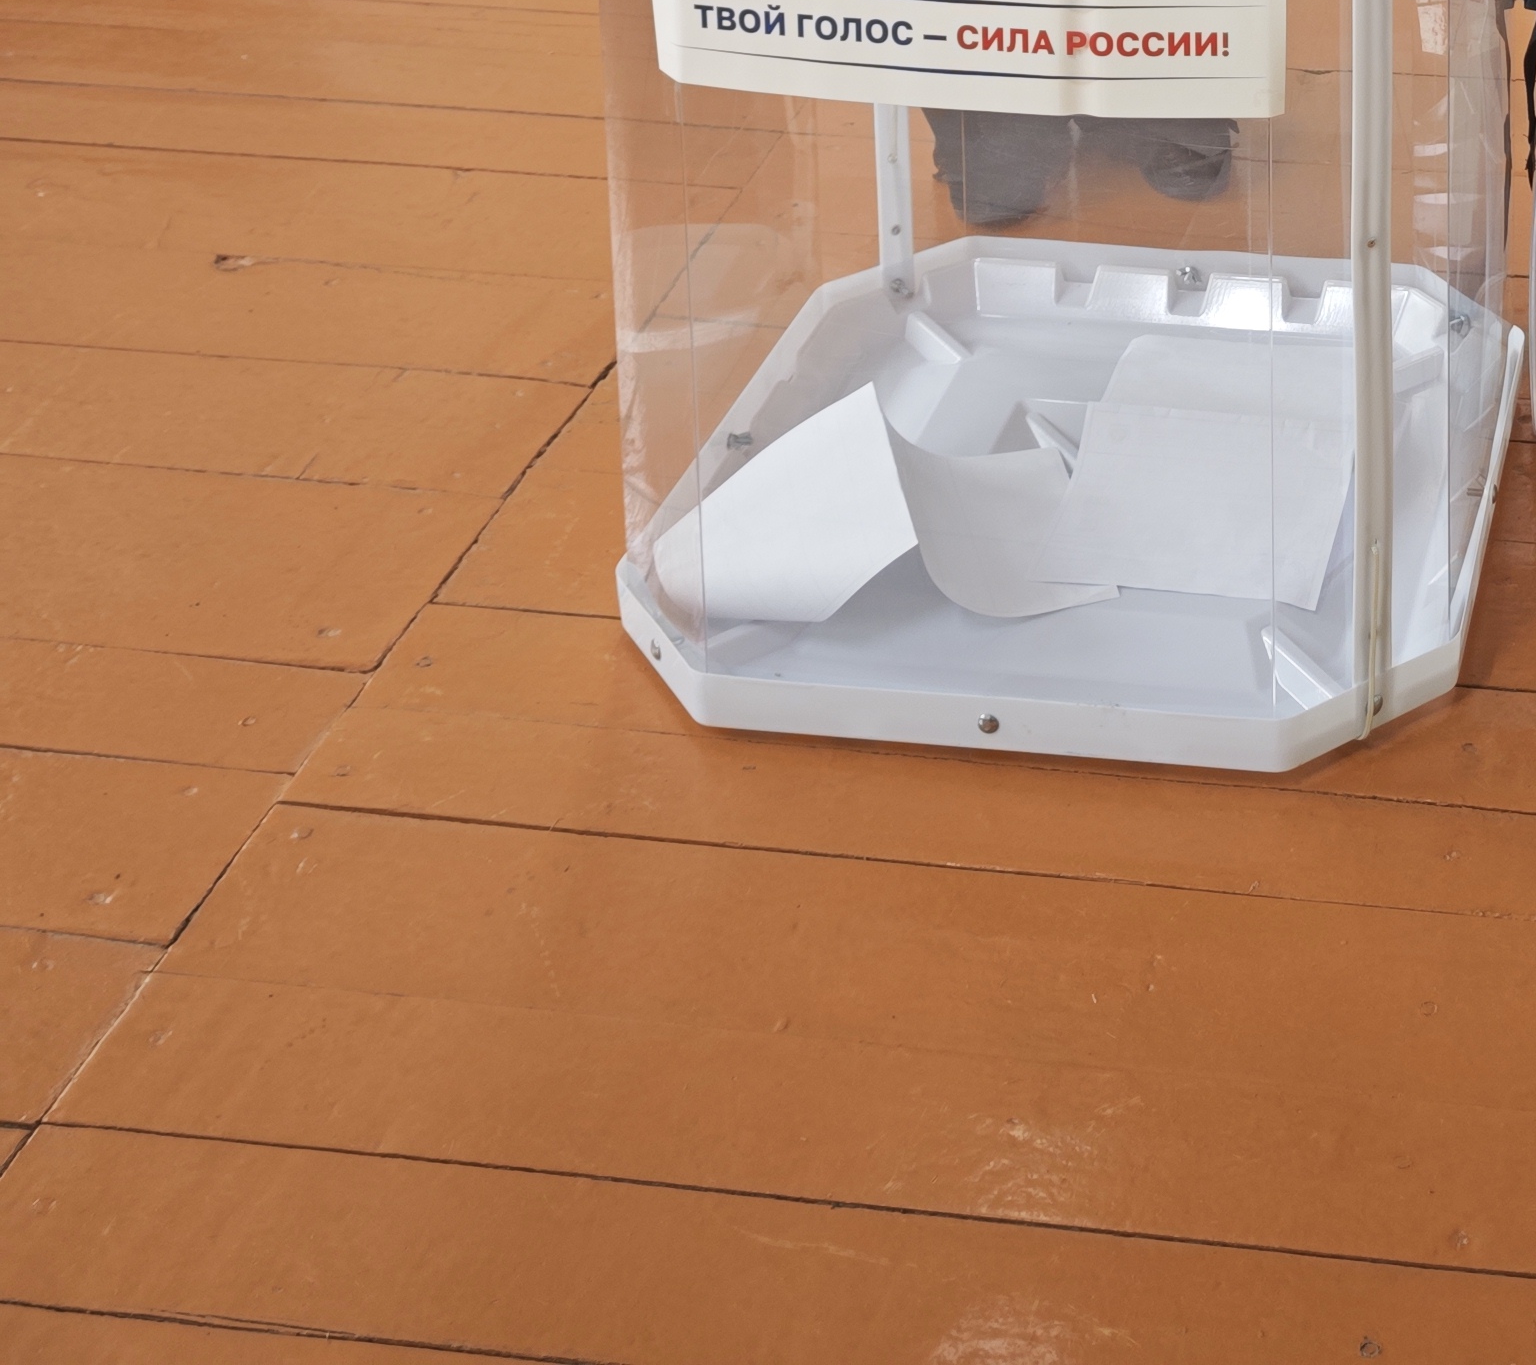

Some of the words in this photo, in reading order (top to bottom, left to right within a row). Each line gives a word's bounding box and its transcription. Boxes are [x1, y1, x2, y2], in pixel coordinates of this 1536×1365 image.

[694, 4, 786, 36] ТВОЙ
[797, 13, 913, 46] ГОЛОС
[956, 24, 1055, 56] СИЛА
[1066, 30, 1230, 58] РОССИИ!
